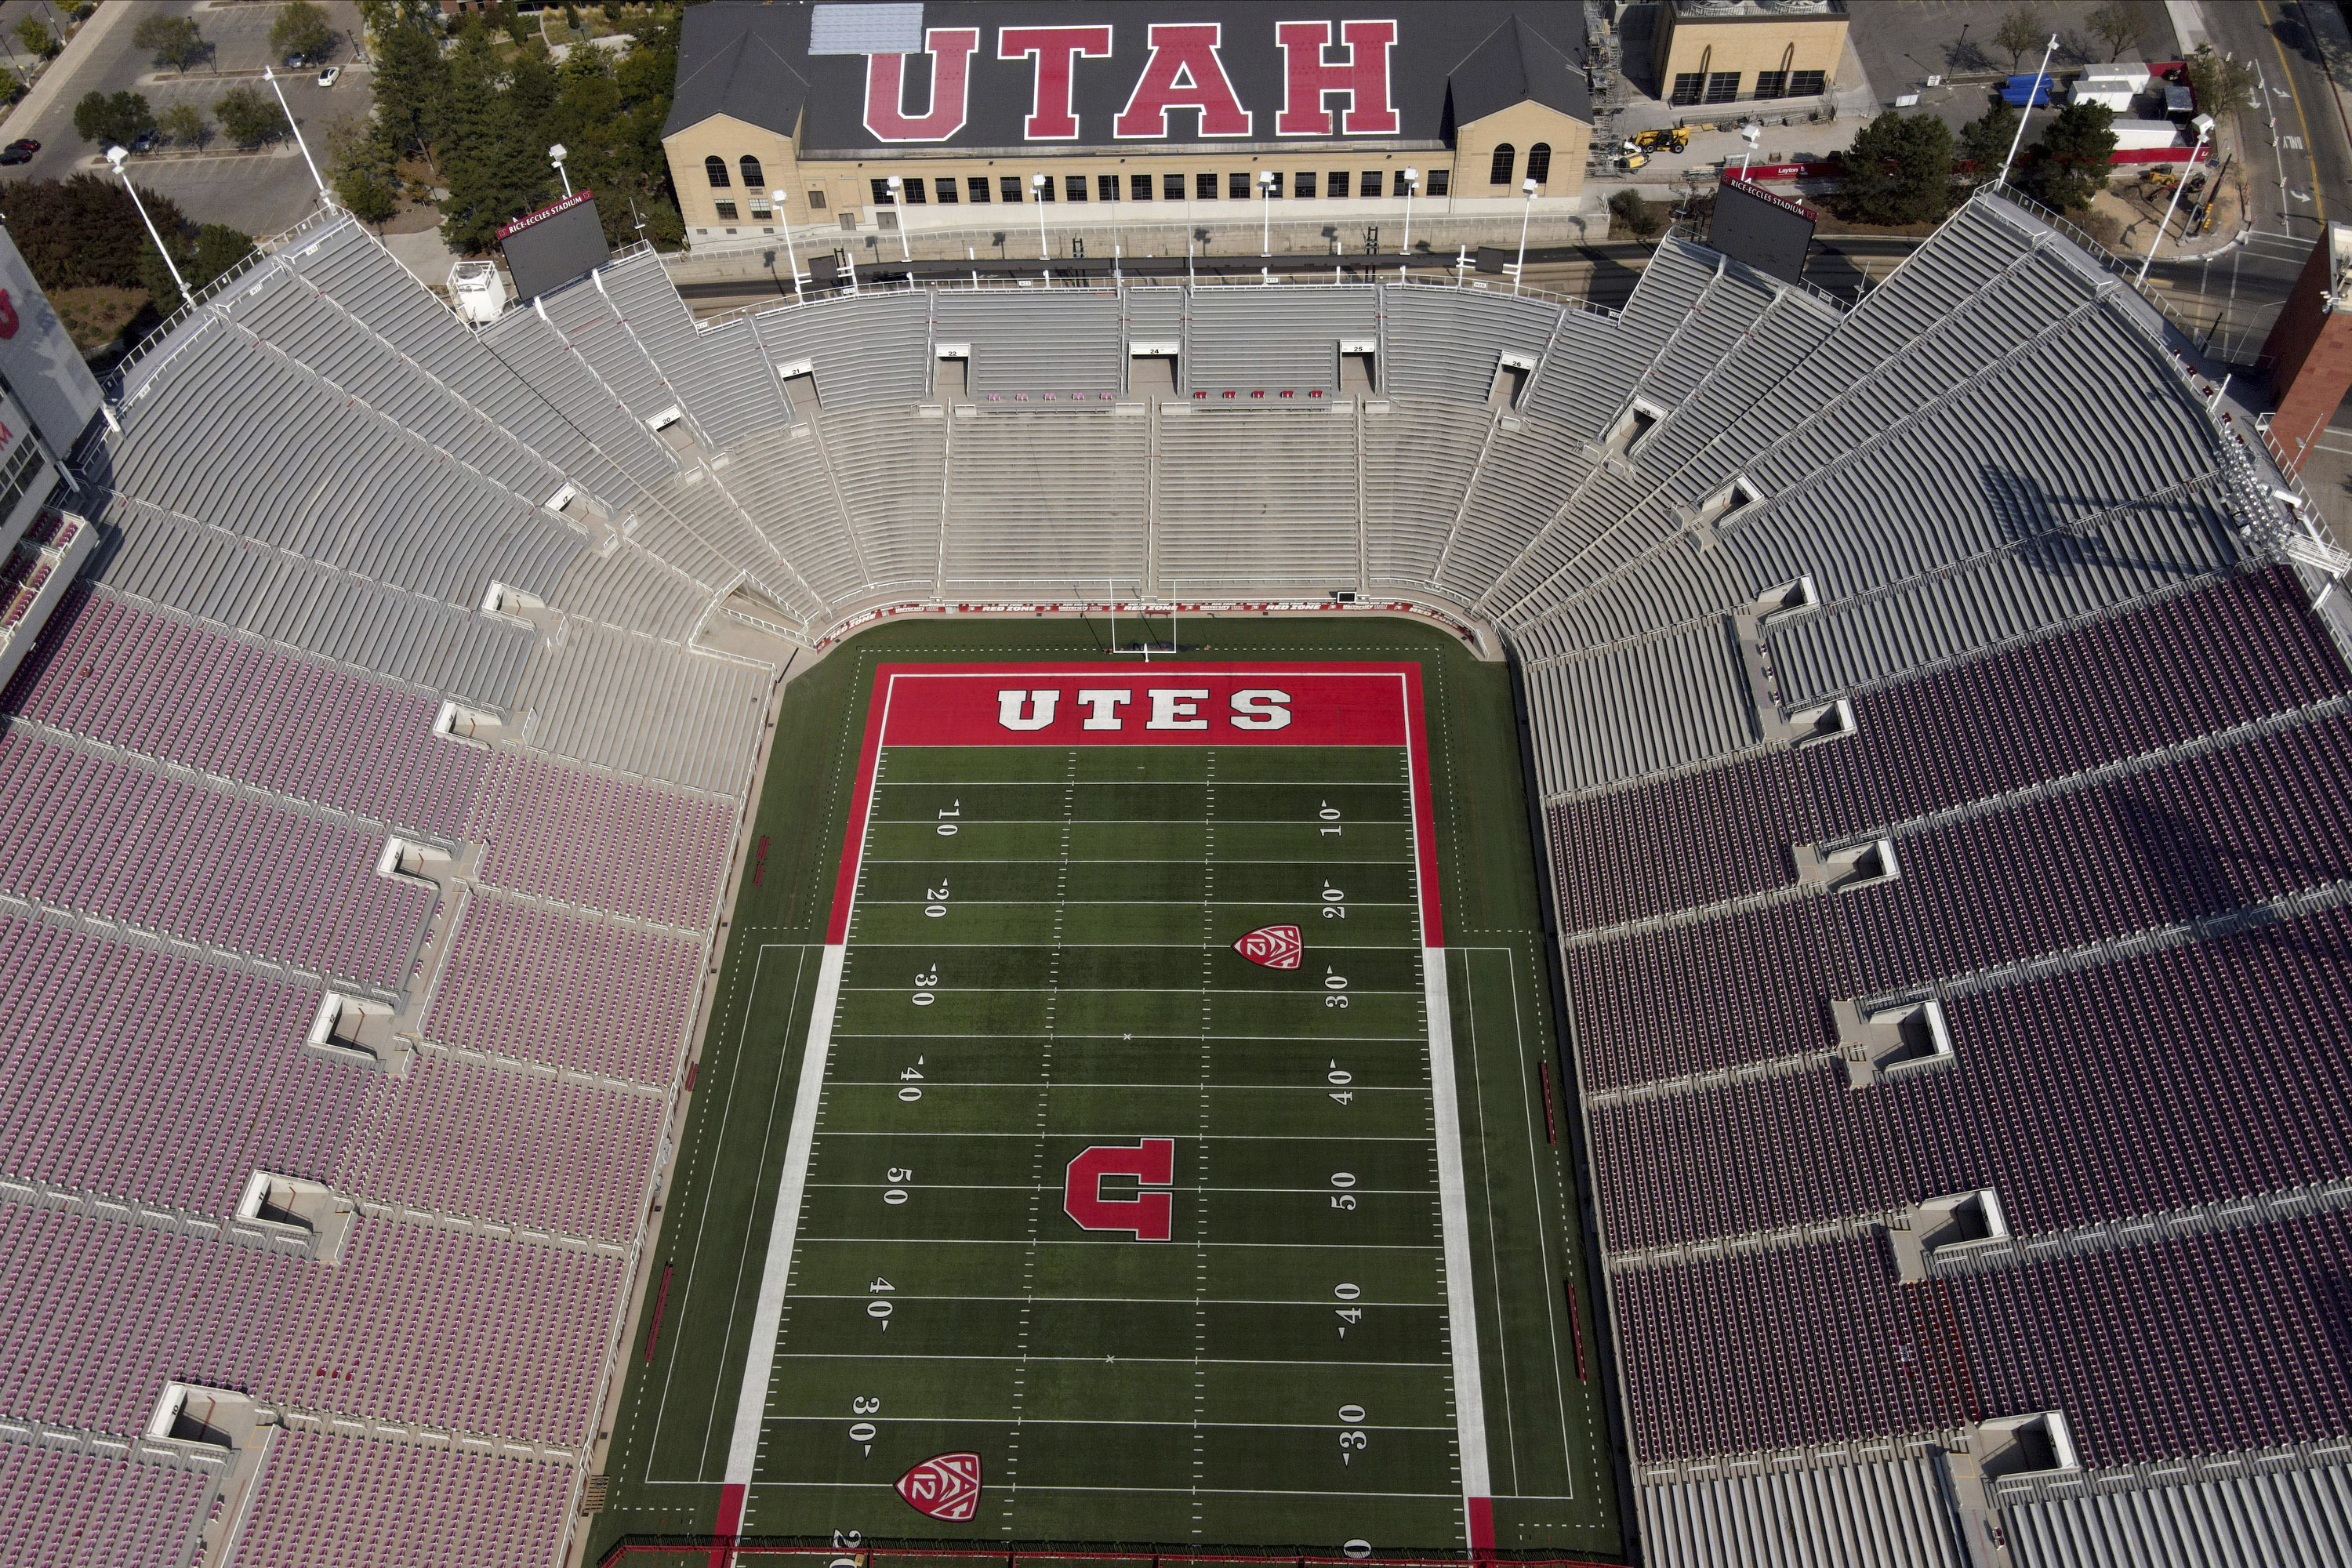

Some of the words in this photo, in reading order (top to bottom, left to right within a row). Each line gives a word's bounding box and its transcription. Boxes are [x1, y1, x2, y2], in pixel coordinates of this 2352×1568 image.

[863, 20, 1399, 143] UTAH
[2283, 136, 2303, 149] ONLY
[1731, 179, 1771, 201] RICE-ECCLES
[1773, 198, 1804, 216] STADIUM
[508, 210, 550, 233] RICE-ECCLES
[550, 196, 582, 214] STADIUM
[830, 625, 848, 641] RED
[849, 613, 877, 629] ZONE
[1409, 606, 1432, 616] RED
[997, 689, 1291, 731] UTES
[936, 808, 960, 837] 10
[1319, 808, 1342, 837] 10
[395, 851, 399, 860] 13
[924, 888, 949, 918] 20
[1322, 888, 1345, 920] 20
[1247, 938, 1266, 956] 12
[912, 973, 938, 1006] 30
[1324, 975, 1348, 1009] 30
[330, 1014, 335, 1023] 12
[898, 1066, 924, 1102] 40
[1327, 1070, 1353, 1105] 40
[259, 1192, 263, 1200] 11
[883, 1167, 913, 1205] 50
[1063, 1138, 1174, 1241] U
[1330, 1172, 1356, 1210] 50
[866, 1276, 896, 1318] 40
[1334, 1283, 1362, 1324] 40
[172, 1404, 179, 1415] 10
[849, 1396, 880, 1442] 30
[1338, 1403, 1367, 1450] 30
[912, 1474, 936, 1500] 12
